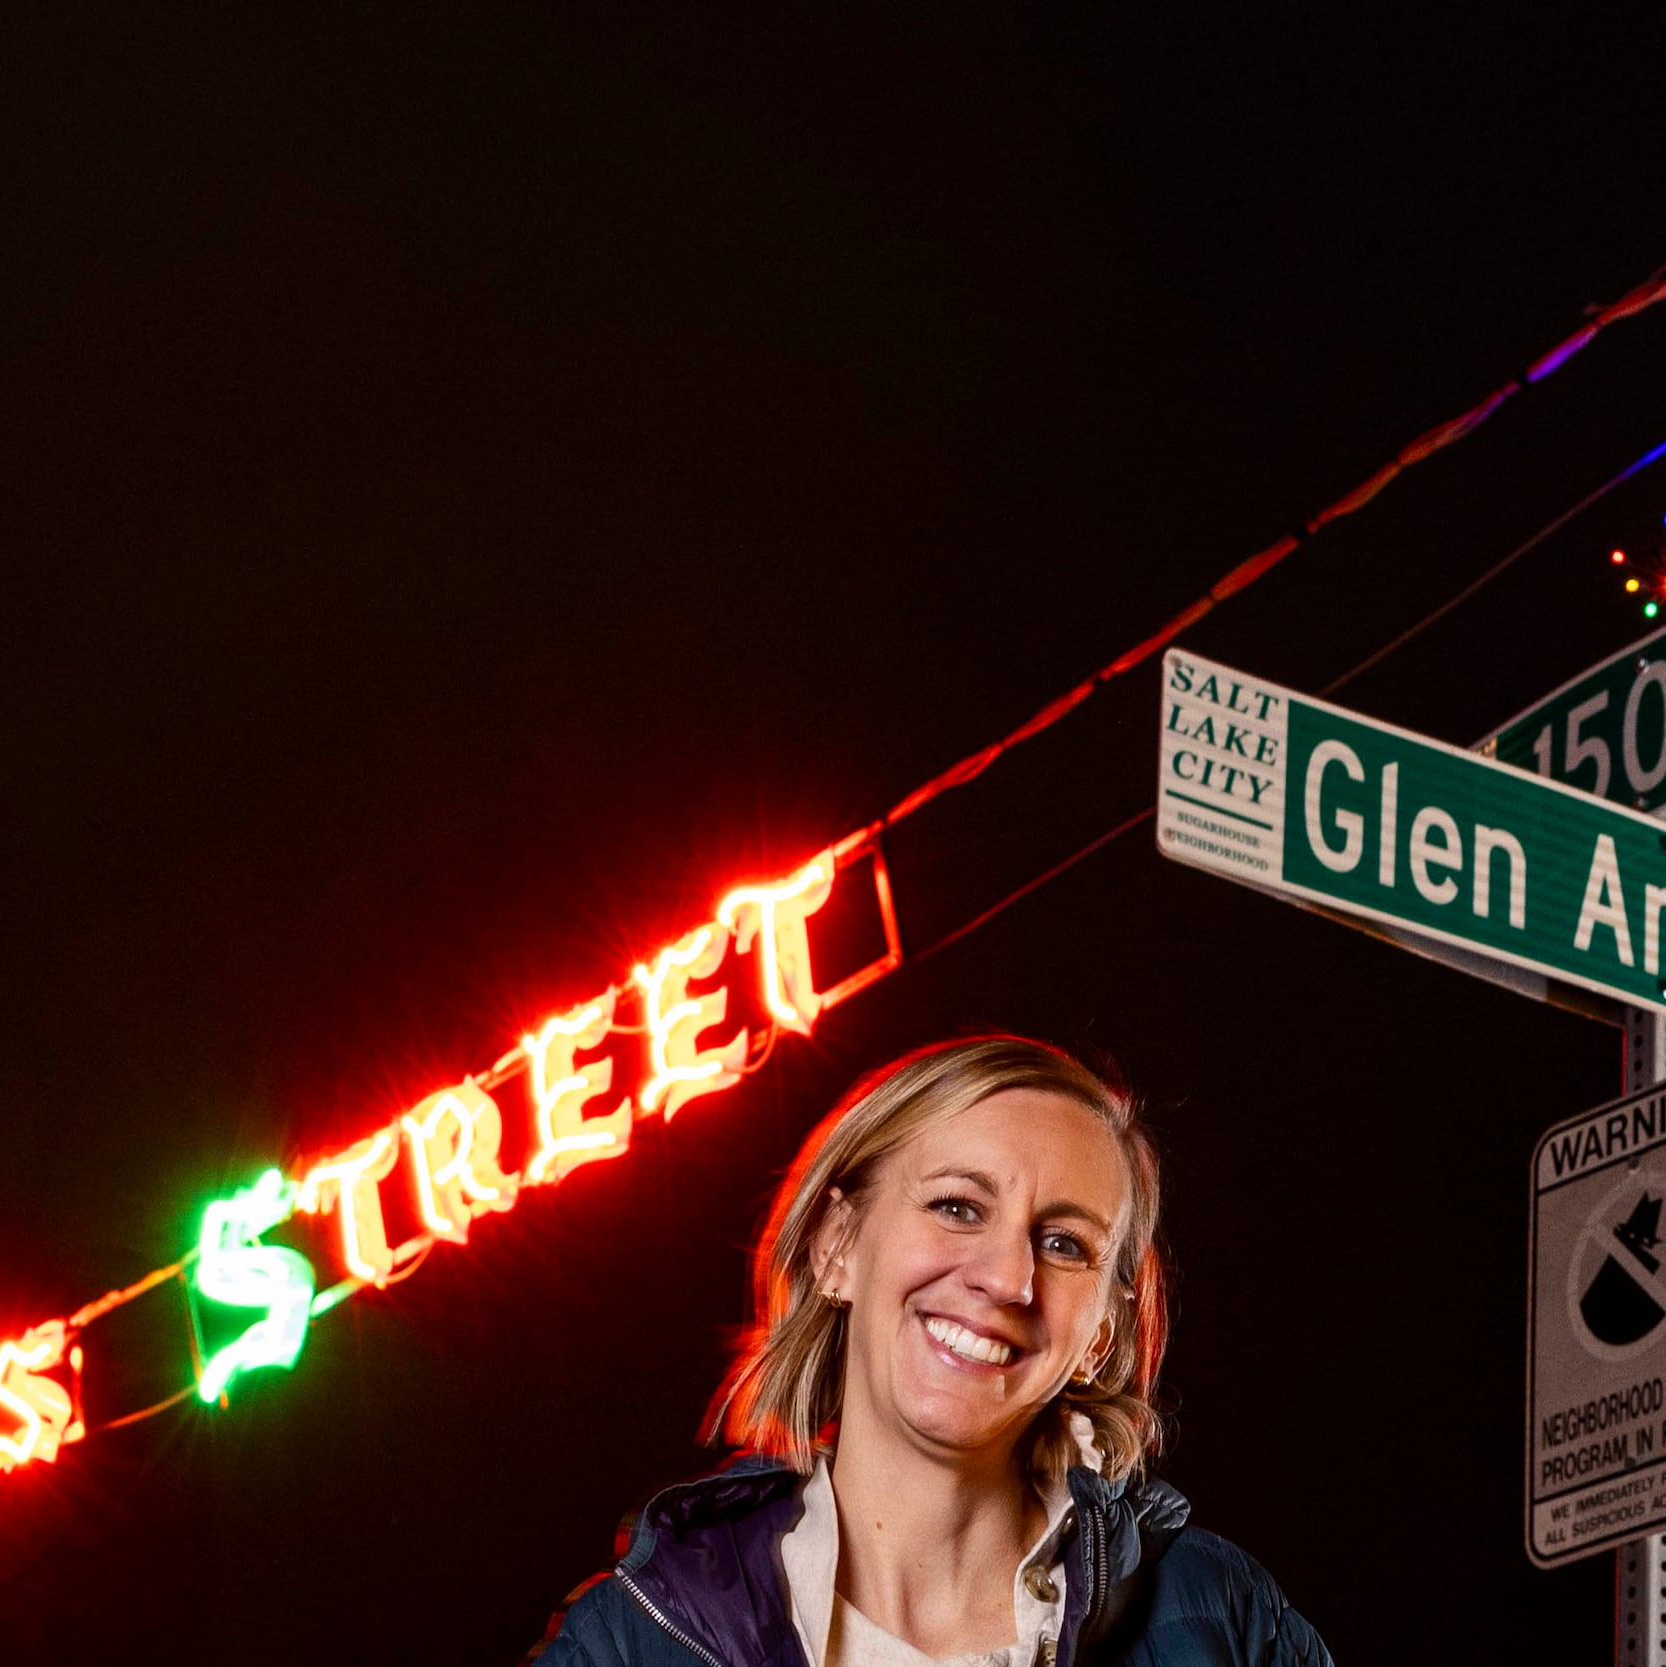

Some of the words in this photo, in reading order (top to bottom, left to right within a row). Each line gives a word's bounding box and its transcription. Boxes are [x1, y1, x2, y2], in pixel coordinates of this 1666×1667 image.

[1171, 663, 1279, 721] SALT
[1165, 703, 1279, 766] LAKE
[1172, 750, 1273, 804] CITY
[1170, 830, 1269, 871] EIGHBORHOOD
[1177, 811, 1260, 848] SUGARHOUSE
[1304, 740, 1526, 930] Glen
[197, 850, 834, 1402] STREET
[1542, 1378, 1664, 1449] NEIGHBORHOOD
[1541, 1434, 1628, 1487] PROGRAM
[1636, 1425, 1654, 1457] IN
[1545, 1527, 1567, 1546] ALL
[1573, 1503, 1646, 1537] SUSPICIOUS
[1551, 1504, 1570, 1522] WE
[1576, 1477, 1655, 1513] IMMEDIATELY
